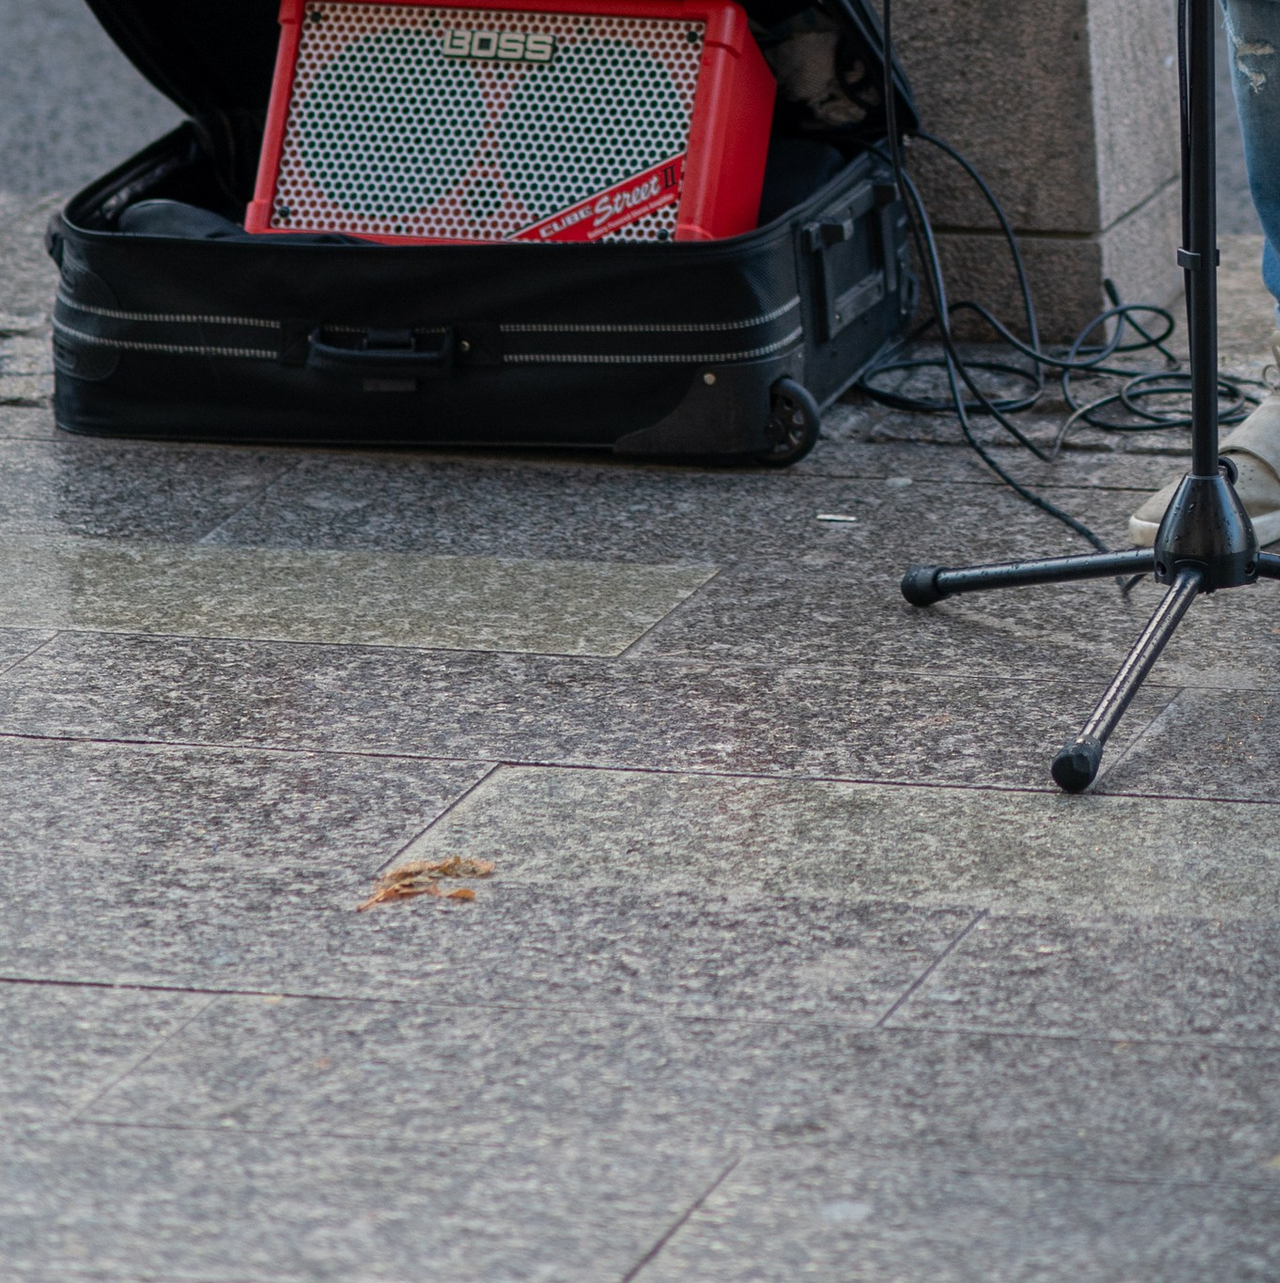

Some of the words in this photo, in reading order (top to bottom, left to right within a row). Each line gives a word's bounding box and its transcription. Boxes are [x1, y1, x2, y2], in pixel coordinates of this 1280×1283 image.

[442, 29, 554, 61] BOSS
[538, 204, 594, 239] CUBE
[592, 175, 661, 227] Street
[662, 165, 677, 189] II
